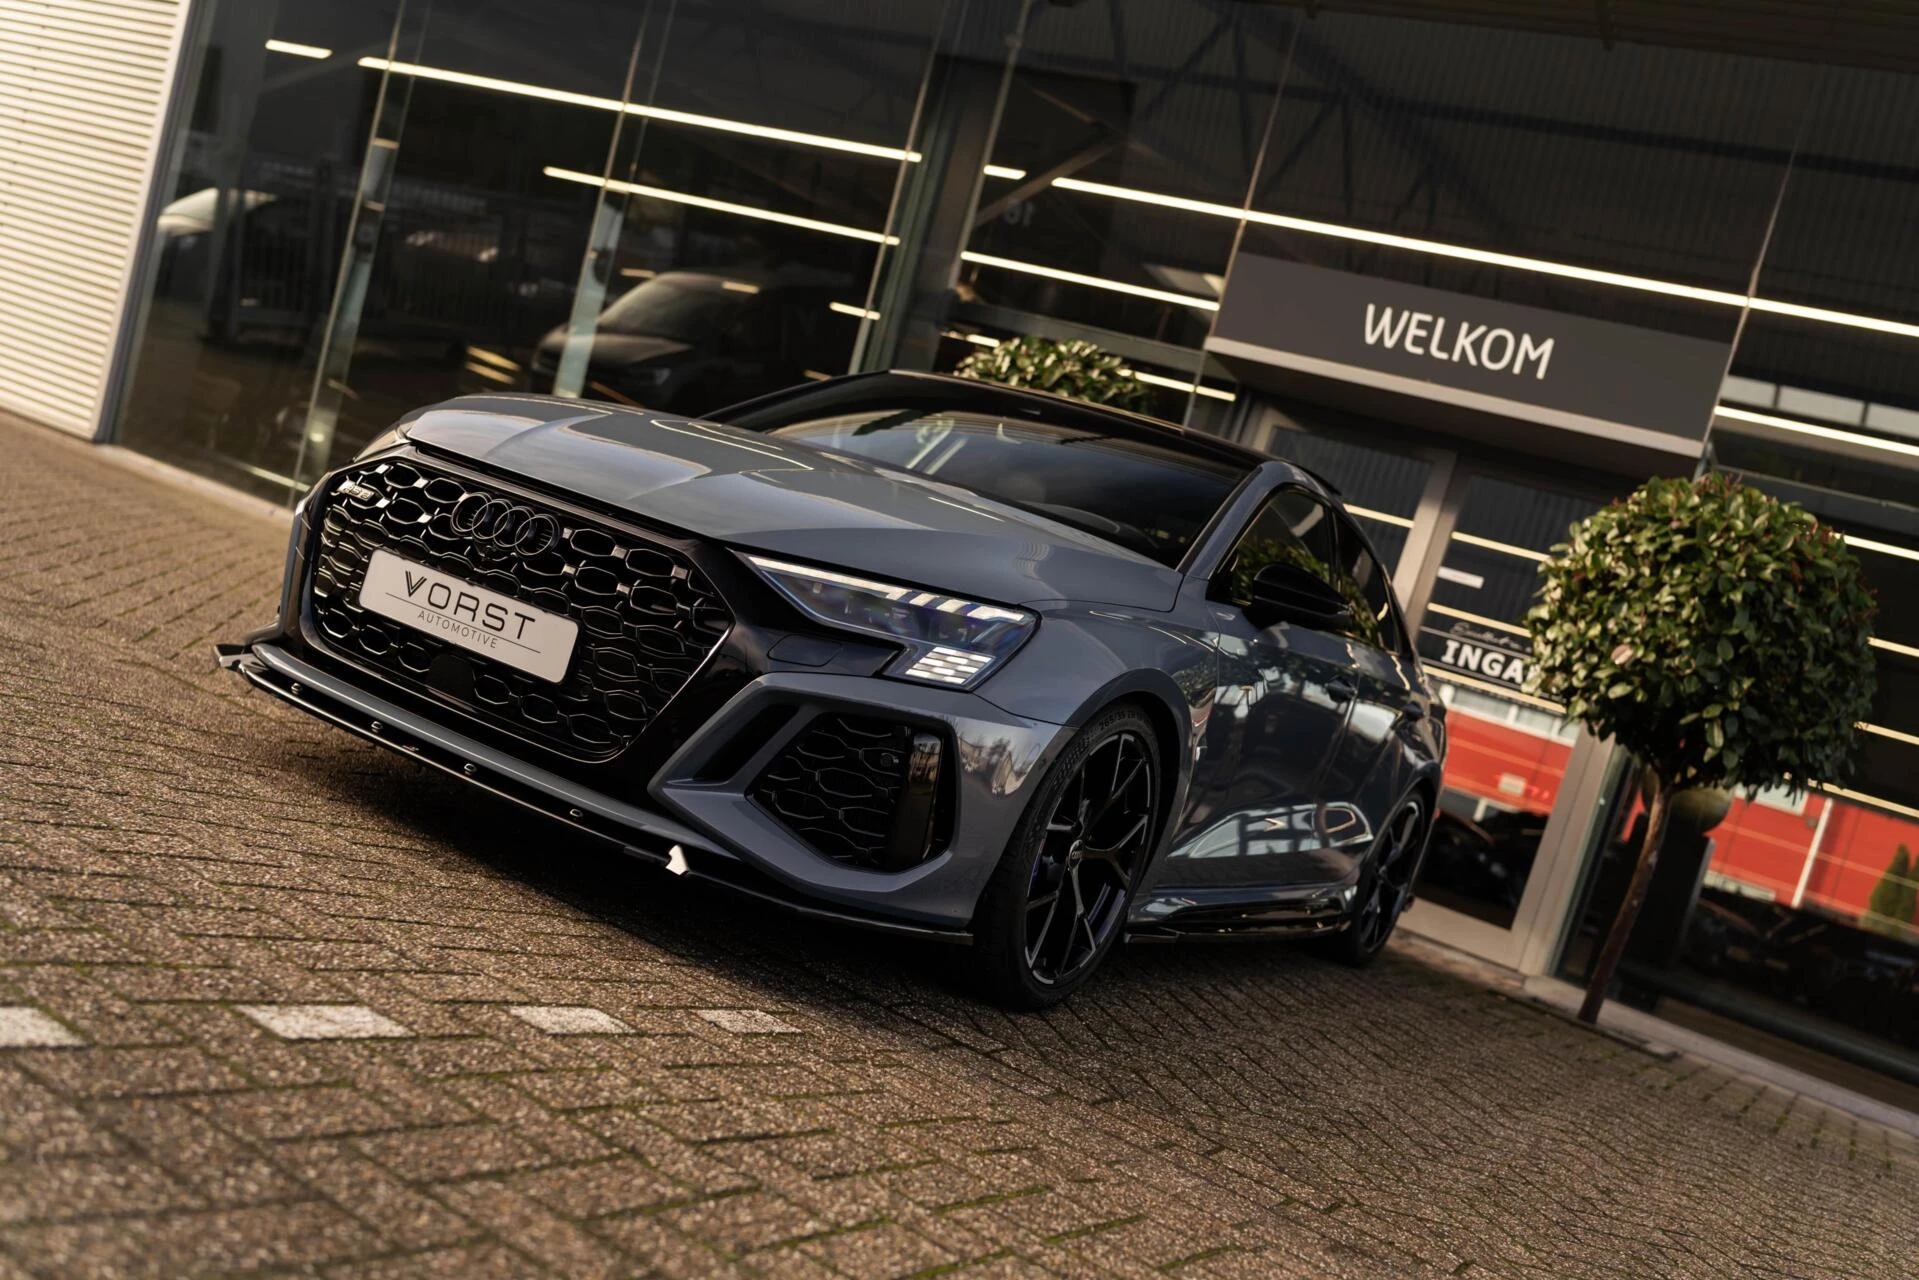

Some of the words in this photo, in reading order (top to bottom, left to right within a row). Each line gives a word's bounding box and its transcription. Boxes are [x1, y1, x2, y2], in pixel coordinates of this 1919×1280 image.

[1364, 303, 1555, 380] WELKOM
[405, 570, 536, 640] VORST
[417, 609, 497, 649] AUTOMOTIVE
